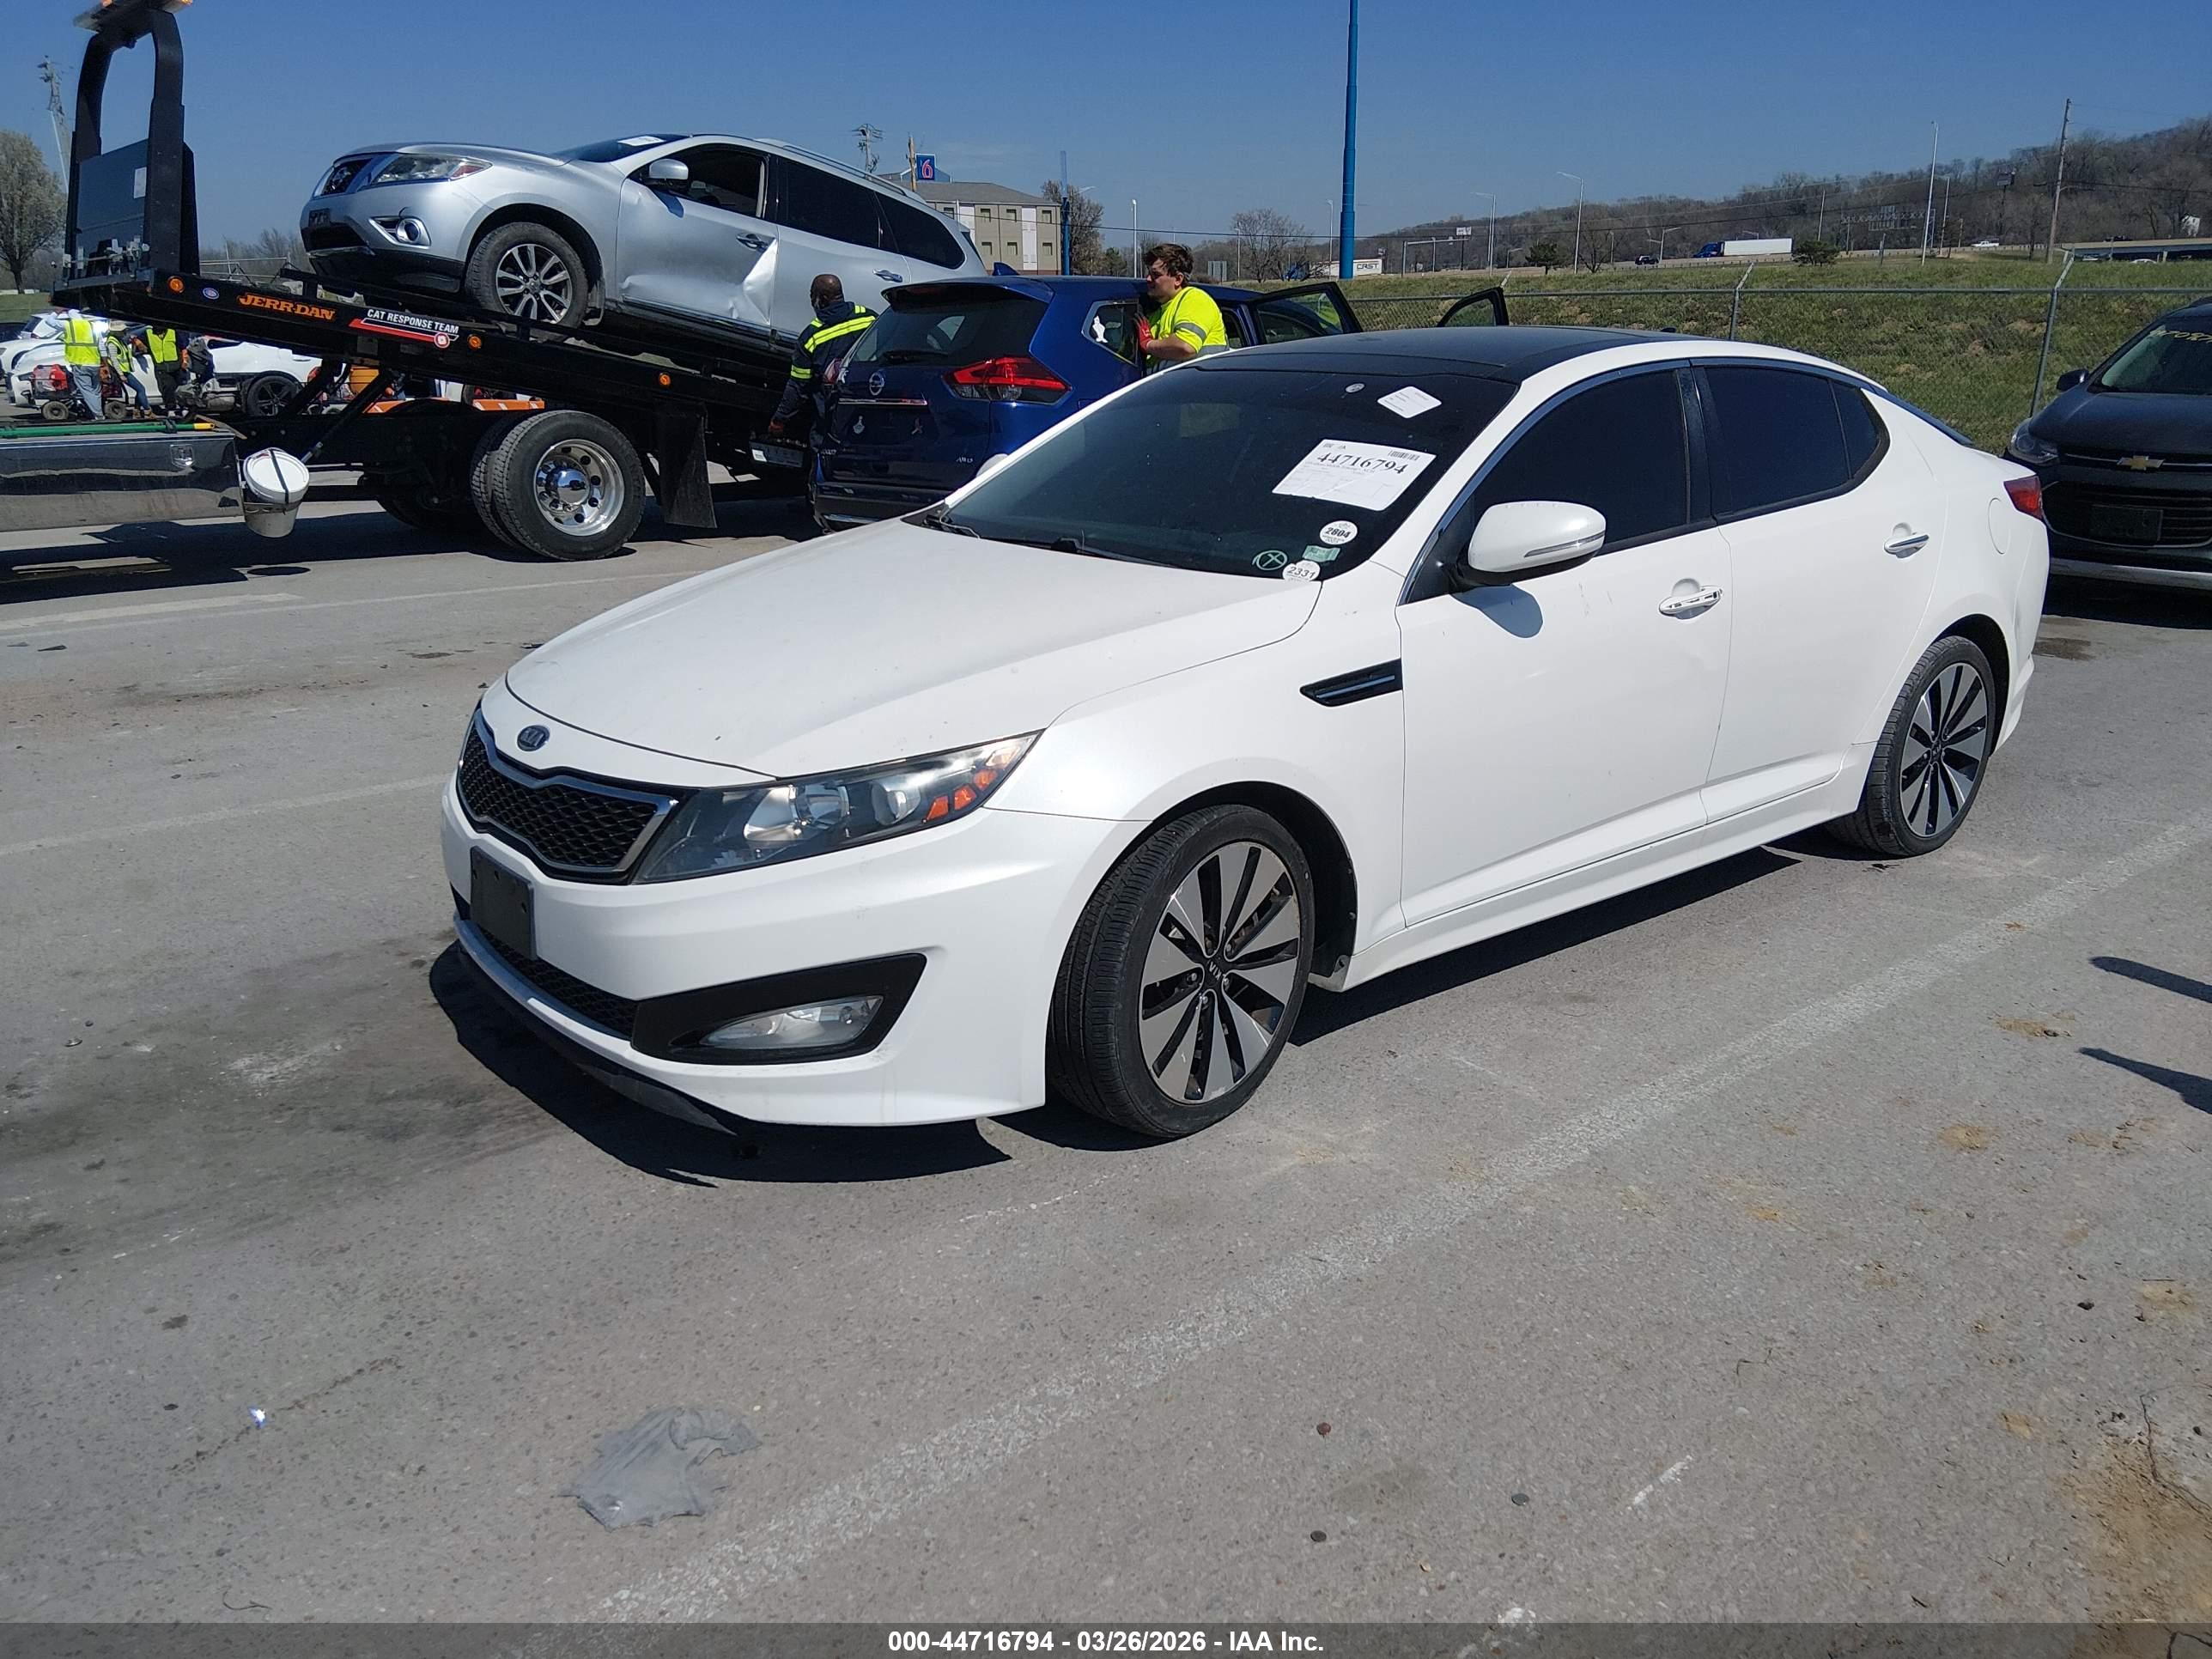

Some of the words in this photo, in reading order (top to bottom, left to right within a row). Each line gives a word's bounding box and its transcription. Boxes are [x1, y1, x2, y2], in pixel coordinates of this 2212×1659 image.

[921, 159, 933, 179] 6
[239, 295, 336, 320] JERR-DAN
[367, 308, 386, 320] CAT
[386, 312, 434, 330] RESPONSE
[434, 321, 459, 334] TEAM
[1316, 453, 1409, 475] 44716794
[1326, 526, 1351, 539] 2804
[1288, 566, 1316, 579] 2331
